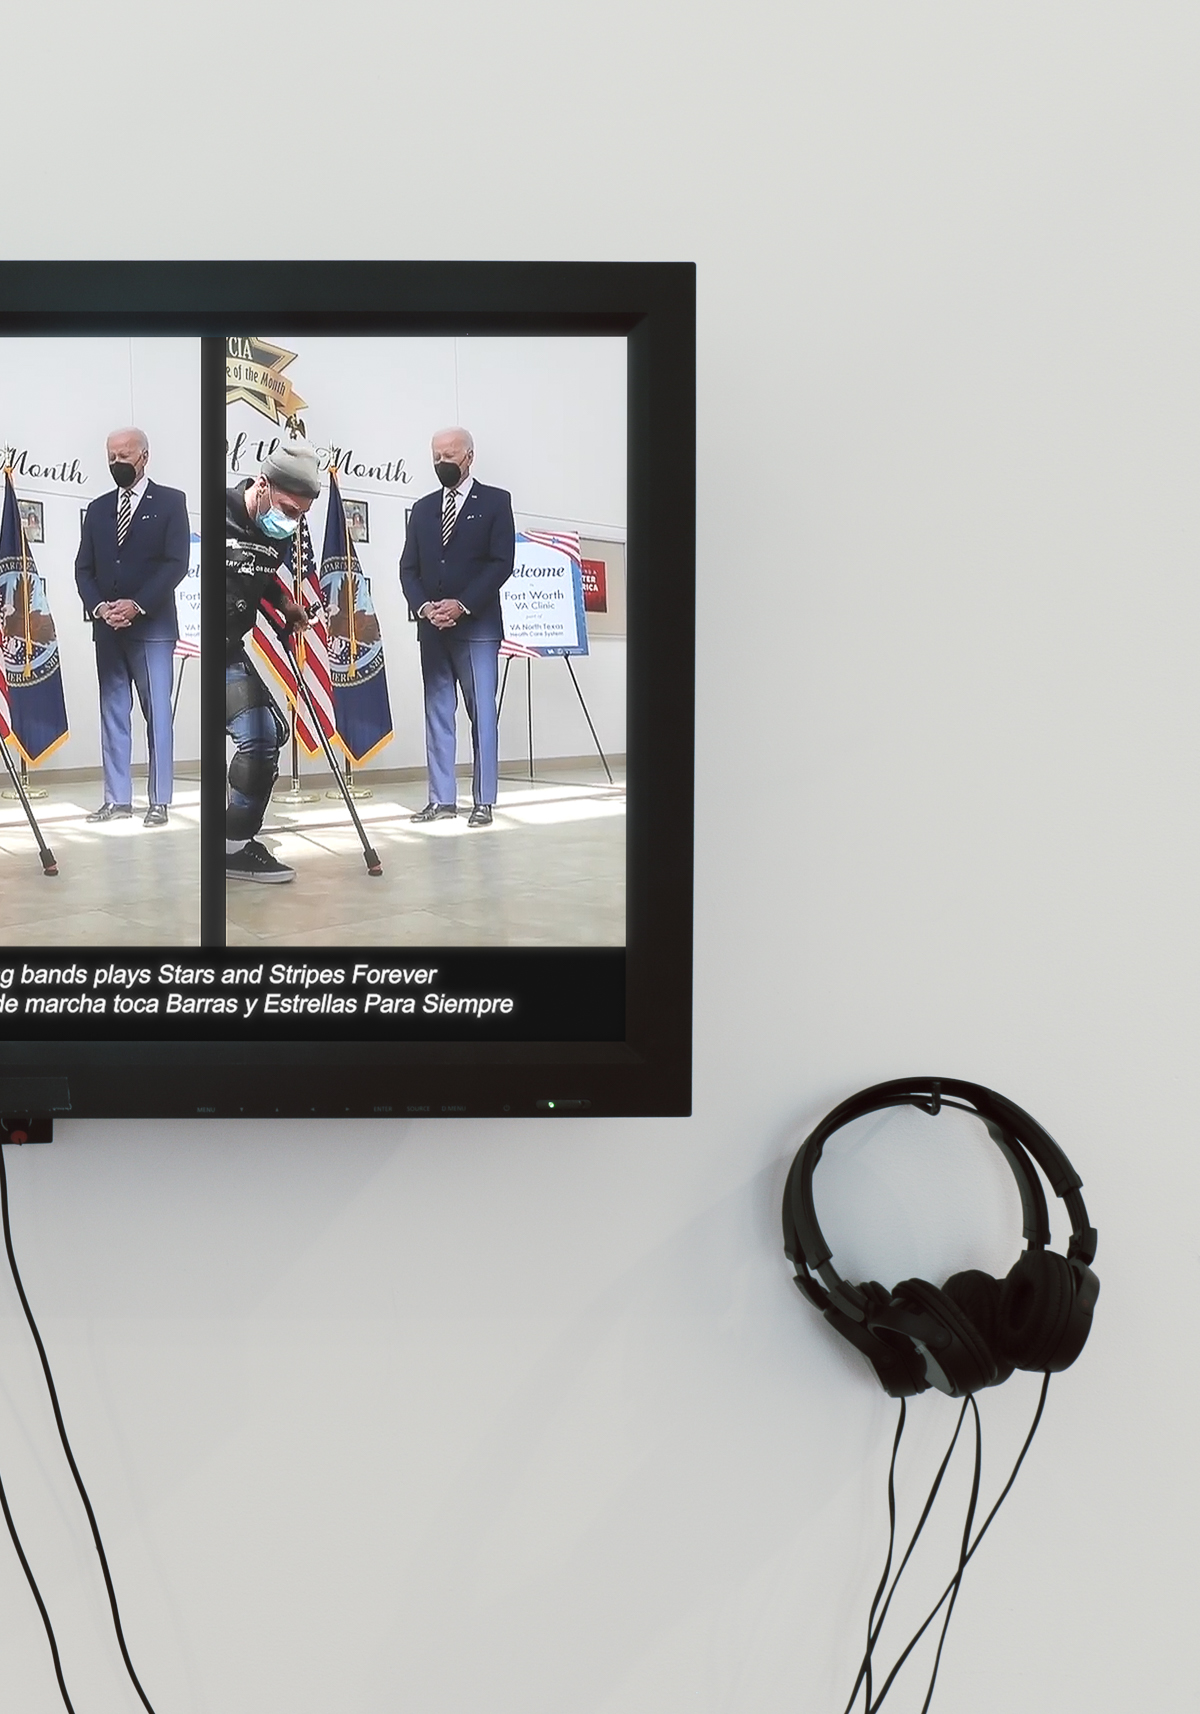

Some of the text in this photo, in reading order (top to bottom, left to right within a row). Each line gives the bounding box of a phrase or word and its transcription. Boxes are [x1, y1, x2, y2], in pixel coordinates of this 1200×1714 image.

[228, 337, 253, 360] CIA
[233, 365, 241, 380] of
[245, 367, 259, 383] the
[260, 372, 286, 396] Month
[315, 446, 414, 485] Month
[512, 564, 565, 579] elcome
[504, 589, 564, 601] Fort Worth
[514, 600, 555, 610] VA Clinic
[21, 964, 87, 984] bands
[93, 964, 151, 988] plays
[158, 964, 215, 984] Stars
[221, 964, 263, 984] and
[269, 964, 345, 988] Stripes
[352, 964, 438, 984] Forever
[25, 994, 106, 1013] marcha
[114, 994, 159, 1013] toca
[166, 994, 238, 1013] Barras
[244, 997, 258, 1018] y
[264, 994, 357, 1013] Estrellas
[365, 994, 415, 1013] Para
[423, 994, 513, 1018] Siempre
